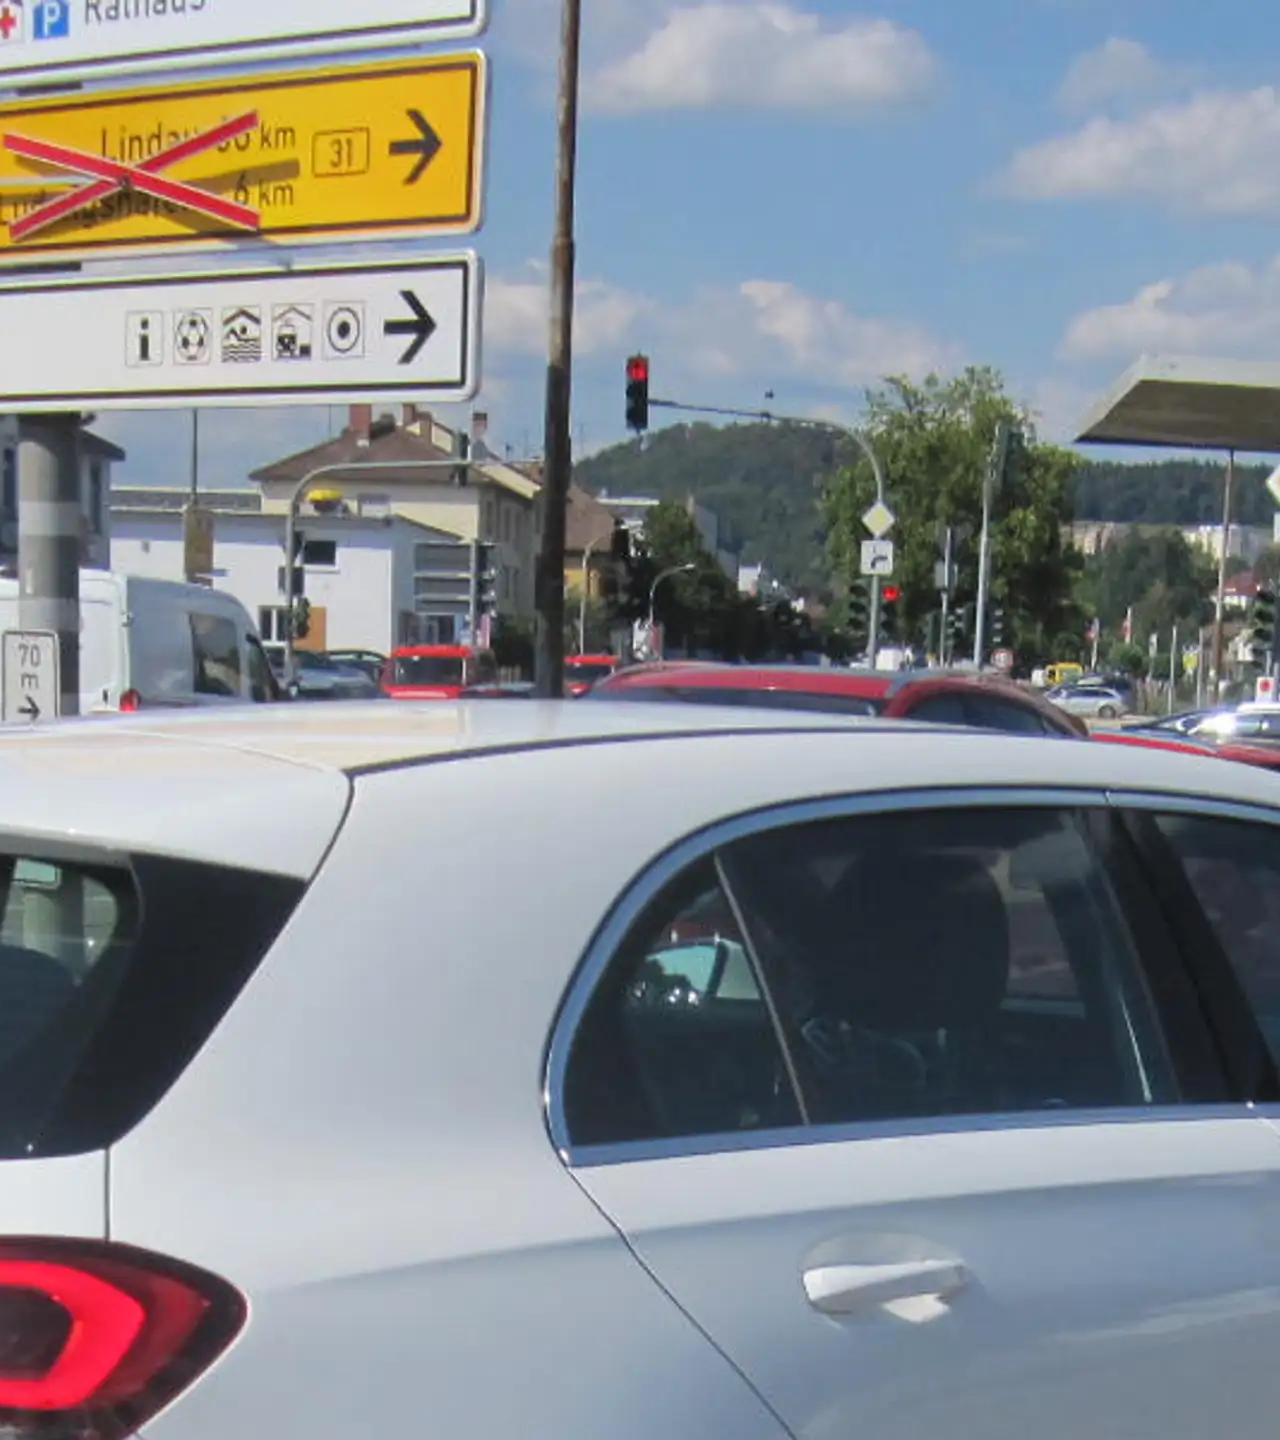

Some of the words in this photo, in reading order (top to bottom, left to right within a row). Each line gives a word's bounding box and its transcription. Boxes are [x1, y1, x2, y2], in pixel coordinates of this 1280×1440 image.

[261, 119, 296, 149] km
[331, 139, 353, 168] 31
[234, 173, 249, 205] 6
[258, 179, 295, 208] km
[18, 643, 41, 667] 70
